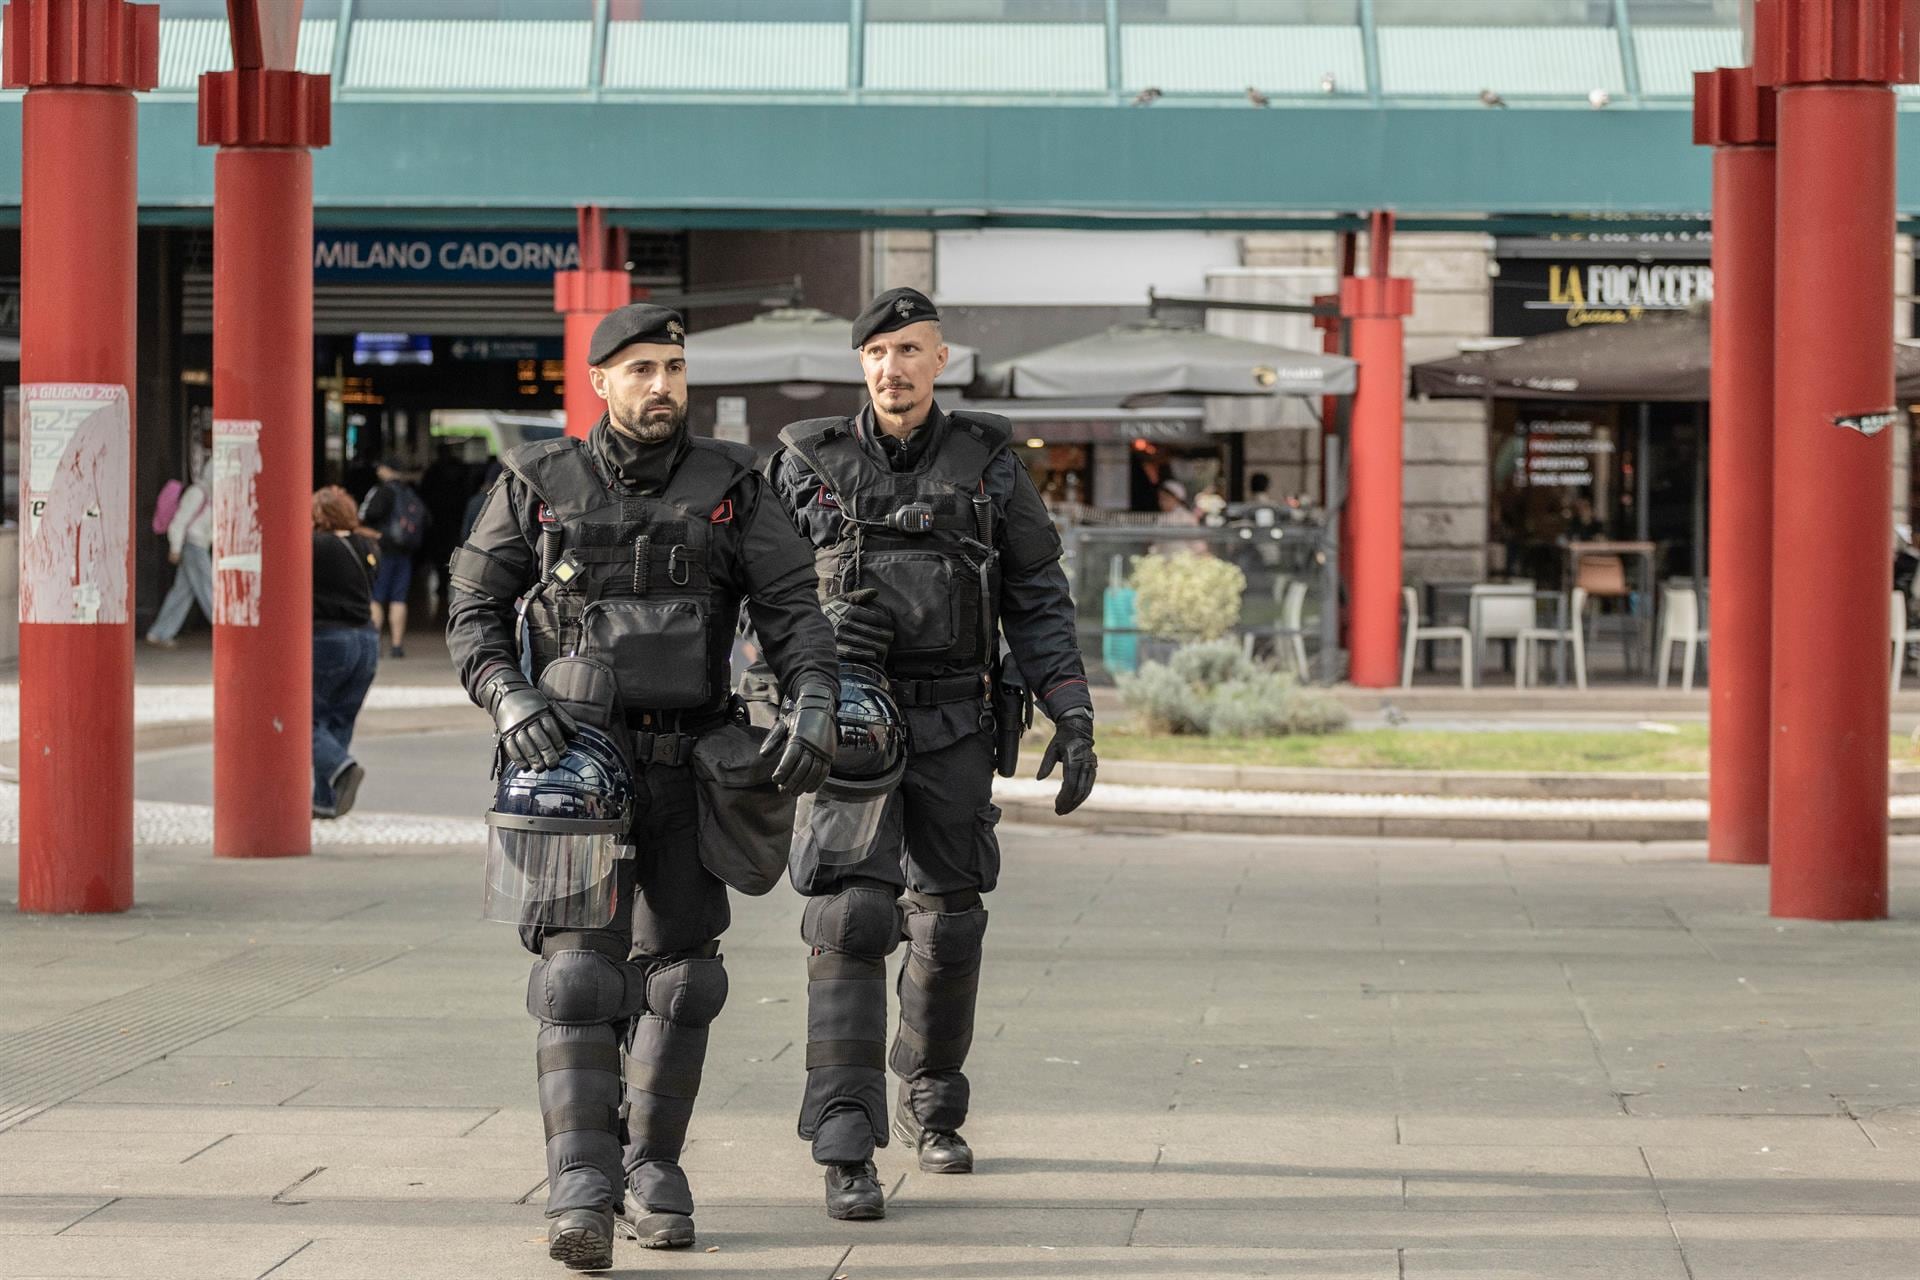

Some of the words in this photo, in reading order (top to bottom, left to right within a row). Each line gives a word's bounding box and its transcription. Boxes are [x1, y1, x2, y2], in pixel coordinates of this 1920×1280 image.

[314, 241, 432, 270] MILANO
[438, 241, 582, 270] CADORNA
[1550, 265, 1583, 305] LA
[40, 387, 93, 399] GIUGNO
